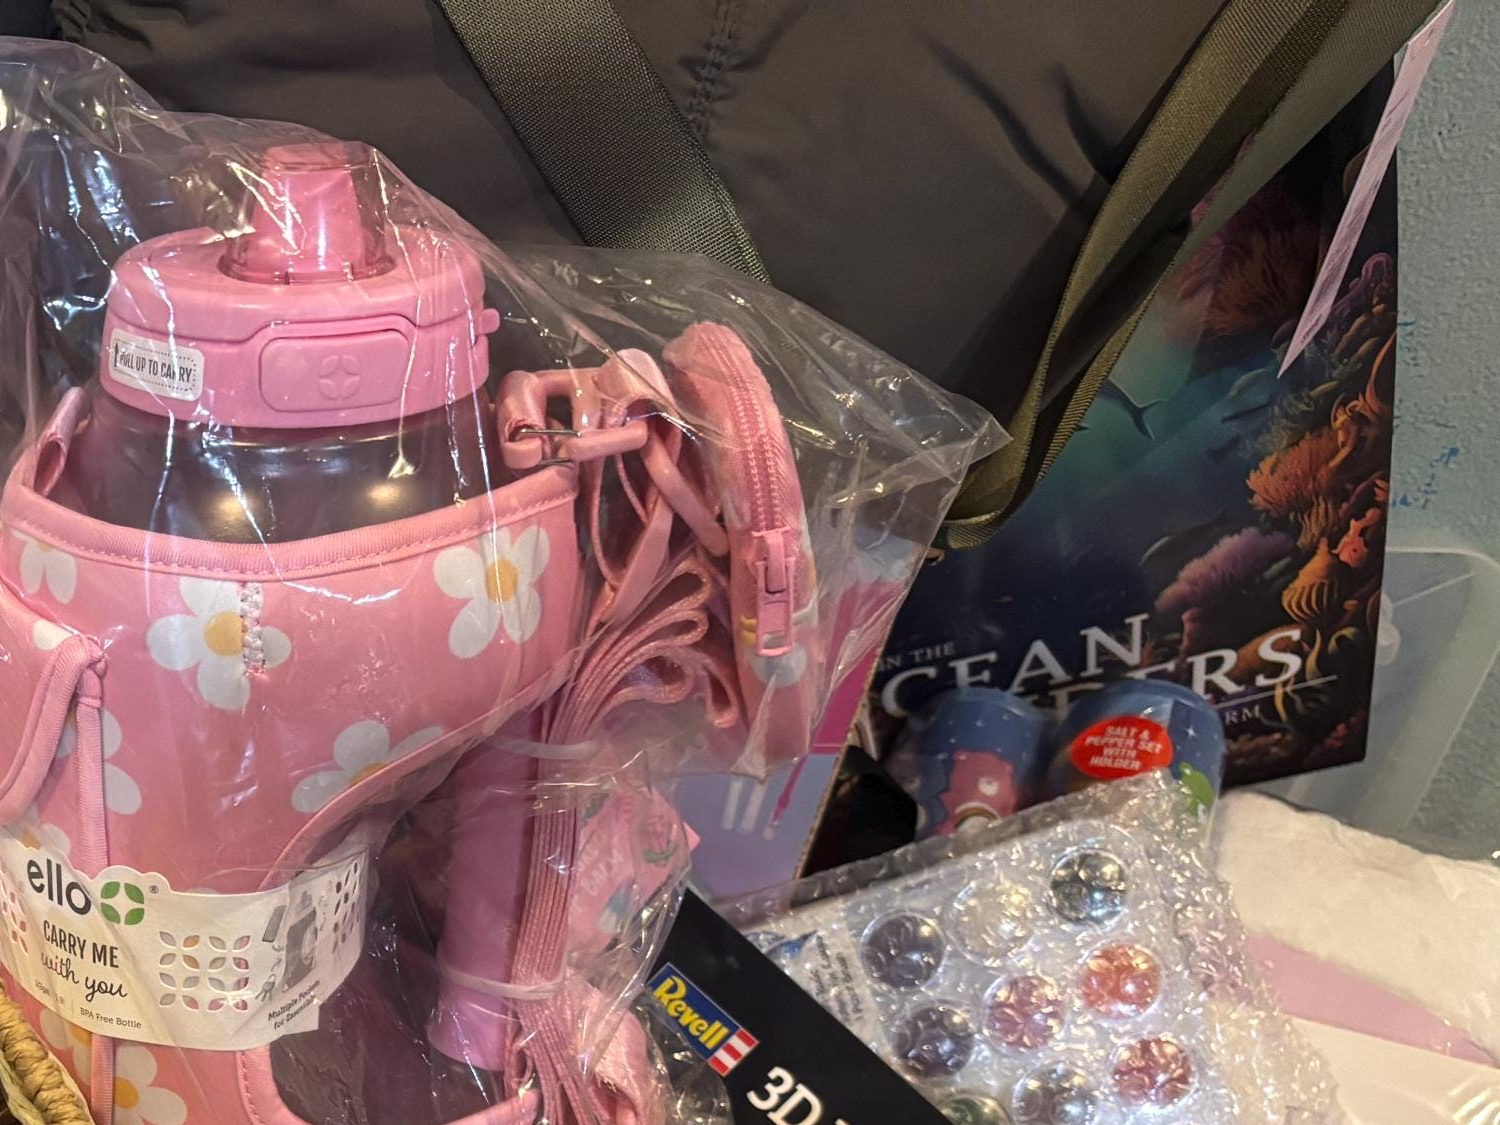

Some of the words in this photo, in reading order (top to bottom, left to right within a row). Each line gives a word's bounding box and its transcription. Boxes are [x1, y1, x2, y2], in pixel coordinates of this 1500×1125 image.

[136, 356, 147, 372] UP
[148, 359, 159, 376] TO
[1105, 726, 1139, 738] SALT
[1084, 736, 1136, 749] PEPPER
[1137, 740, 1163, 754] SET
[1102, 747, 1137, 759] WITH
[1090, 756, 1141, 771] HOLDER
[26, 857, 92, 916] ello
[43, 919, 87, 960] CARRY
[92, 942, 120, 969] ME
[40, 951, 80, 985] with
[85, 975, 128, 1003] you
[80, 1007, 94, 1020] BPA
[96, 1012, 114, 1025] Free
[115, 1016, 142, 1029] Bottle
[652, 974, 730, 1050] Revell
